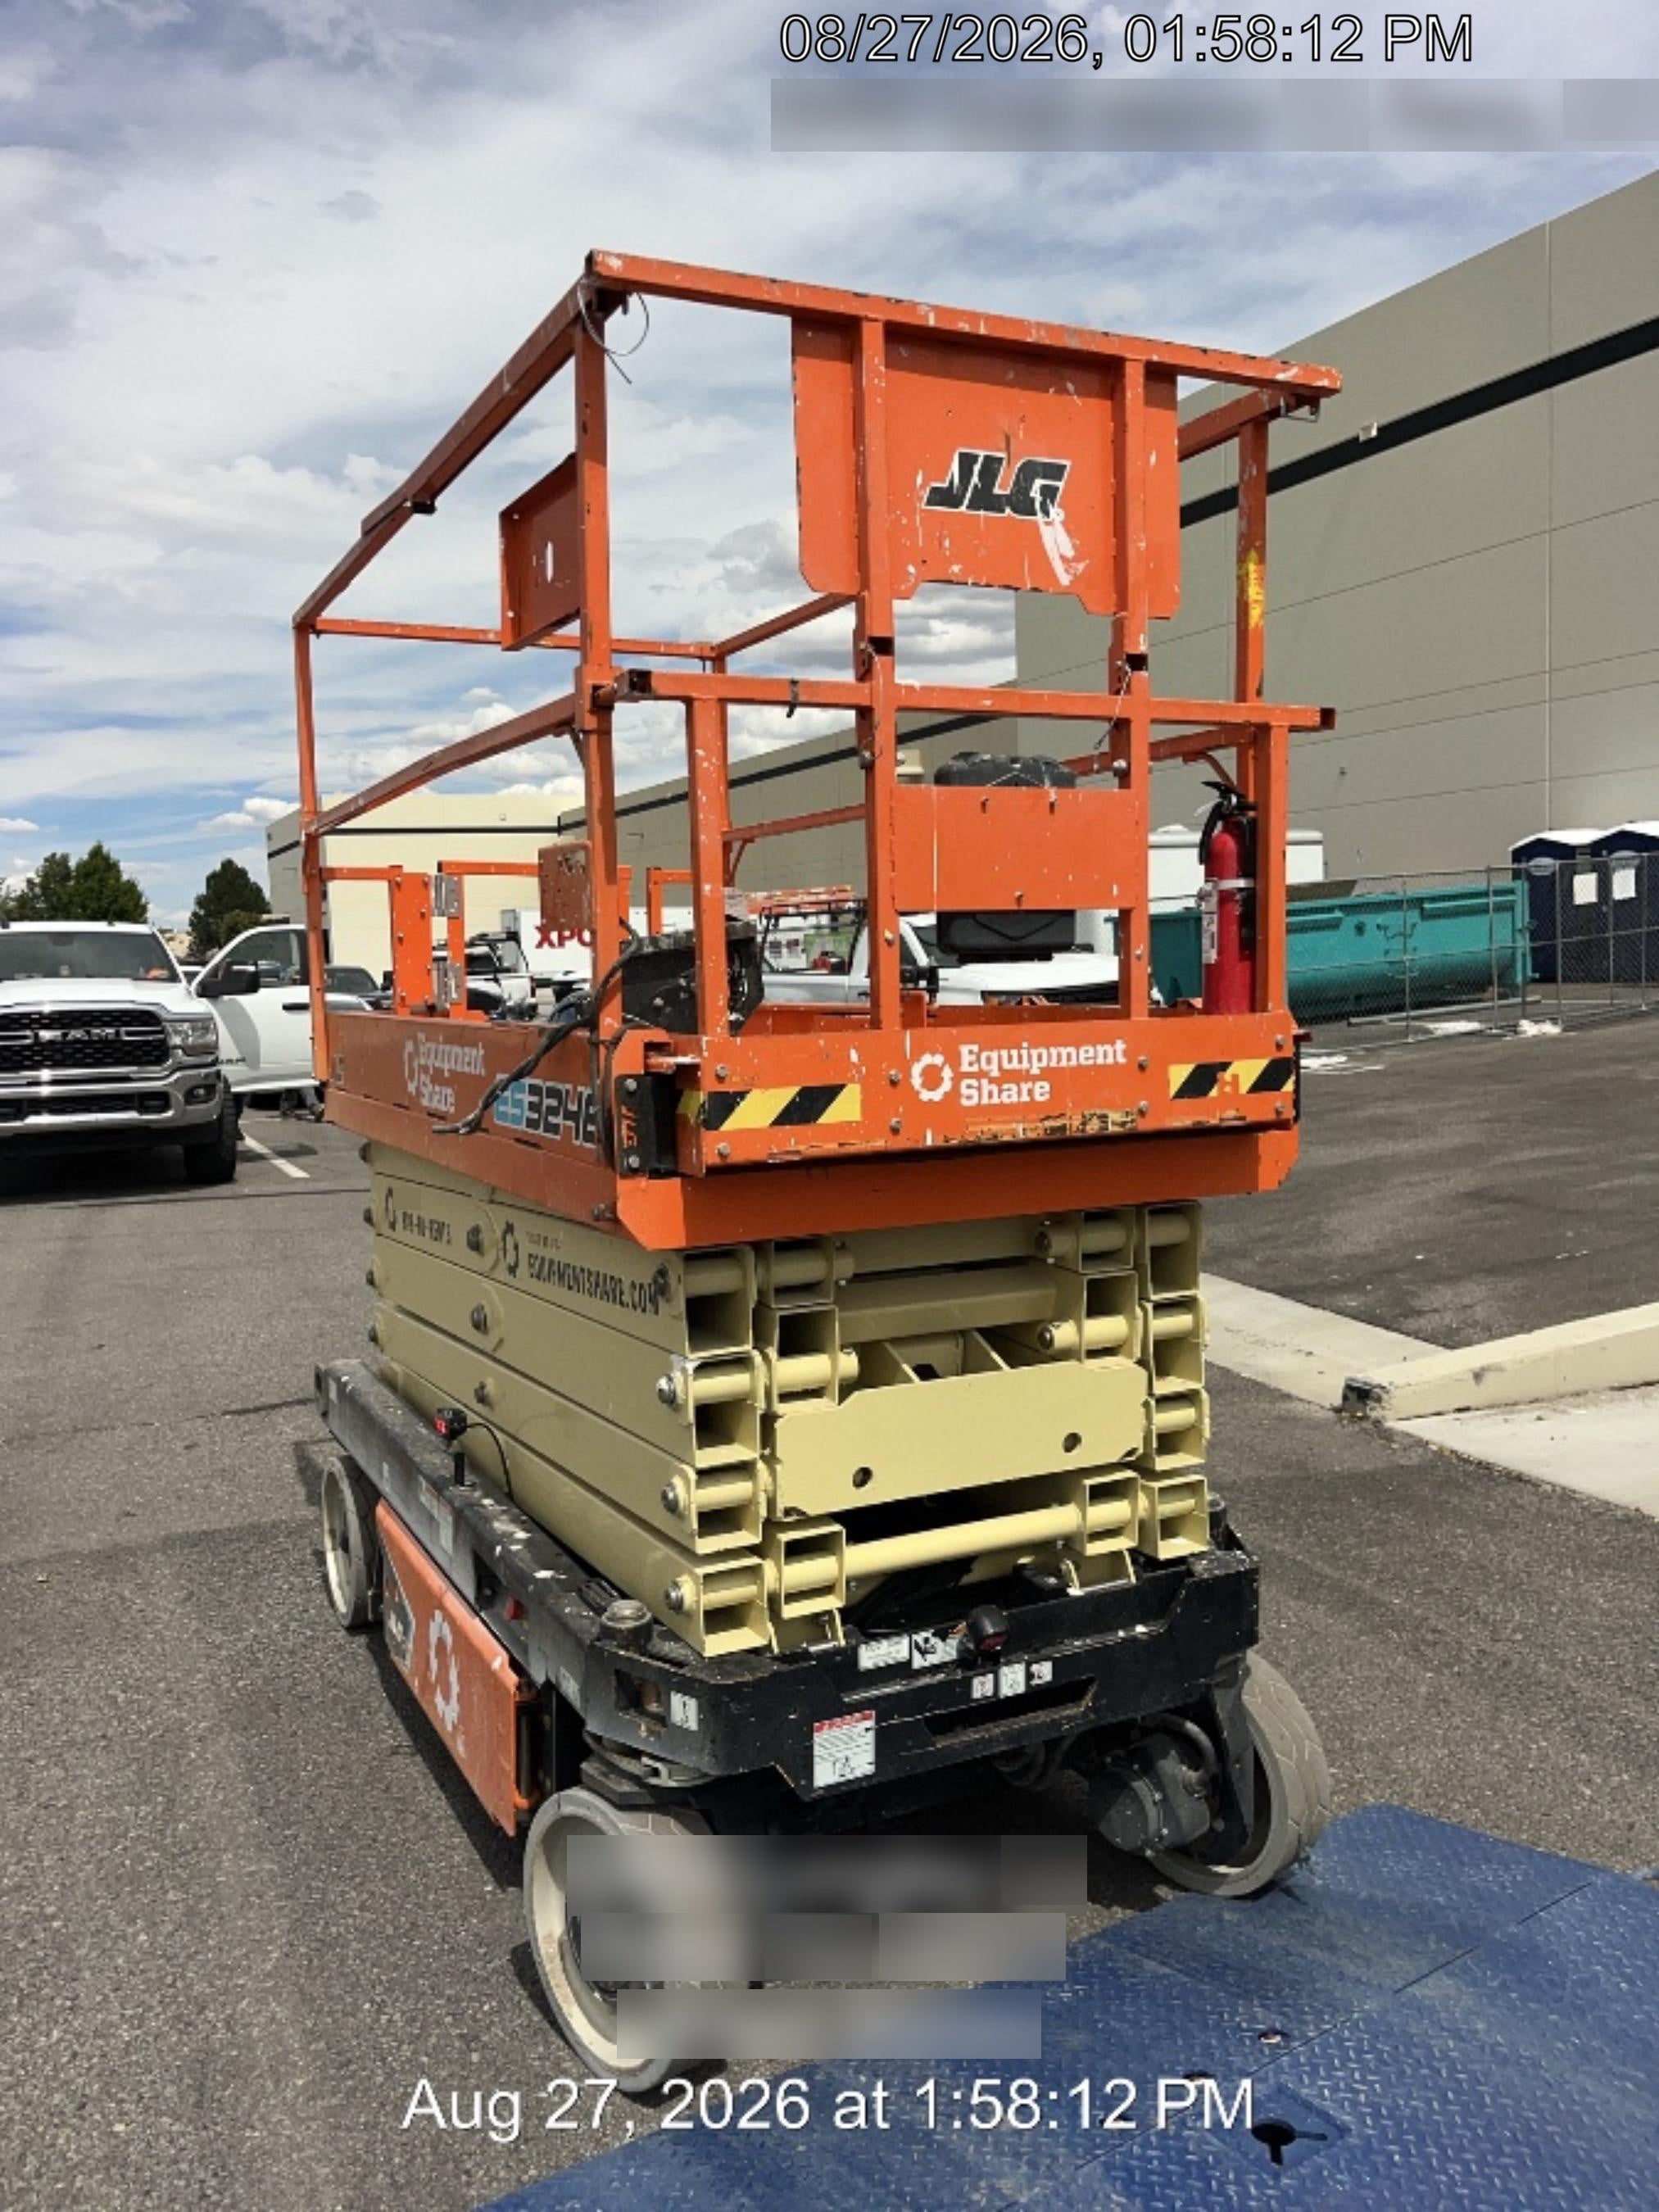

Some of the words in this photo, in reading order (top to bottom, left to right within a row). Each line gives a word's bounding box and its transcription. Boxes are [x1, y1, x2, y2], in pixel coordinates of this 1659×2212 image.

[922, 448, 1072, 522] JLG
[37, 1028, 116, 1041] RAM
[417, 1032, 485, 1076] Equipment
[959, 1039, 1126, 1078] Equipment
[419, 1077, 455, 1113] Share
[959, 1077, 1051, 1107] Share
